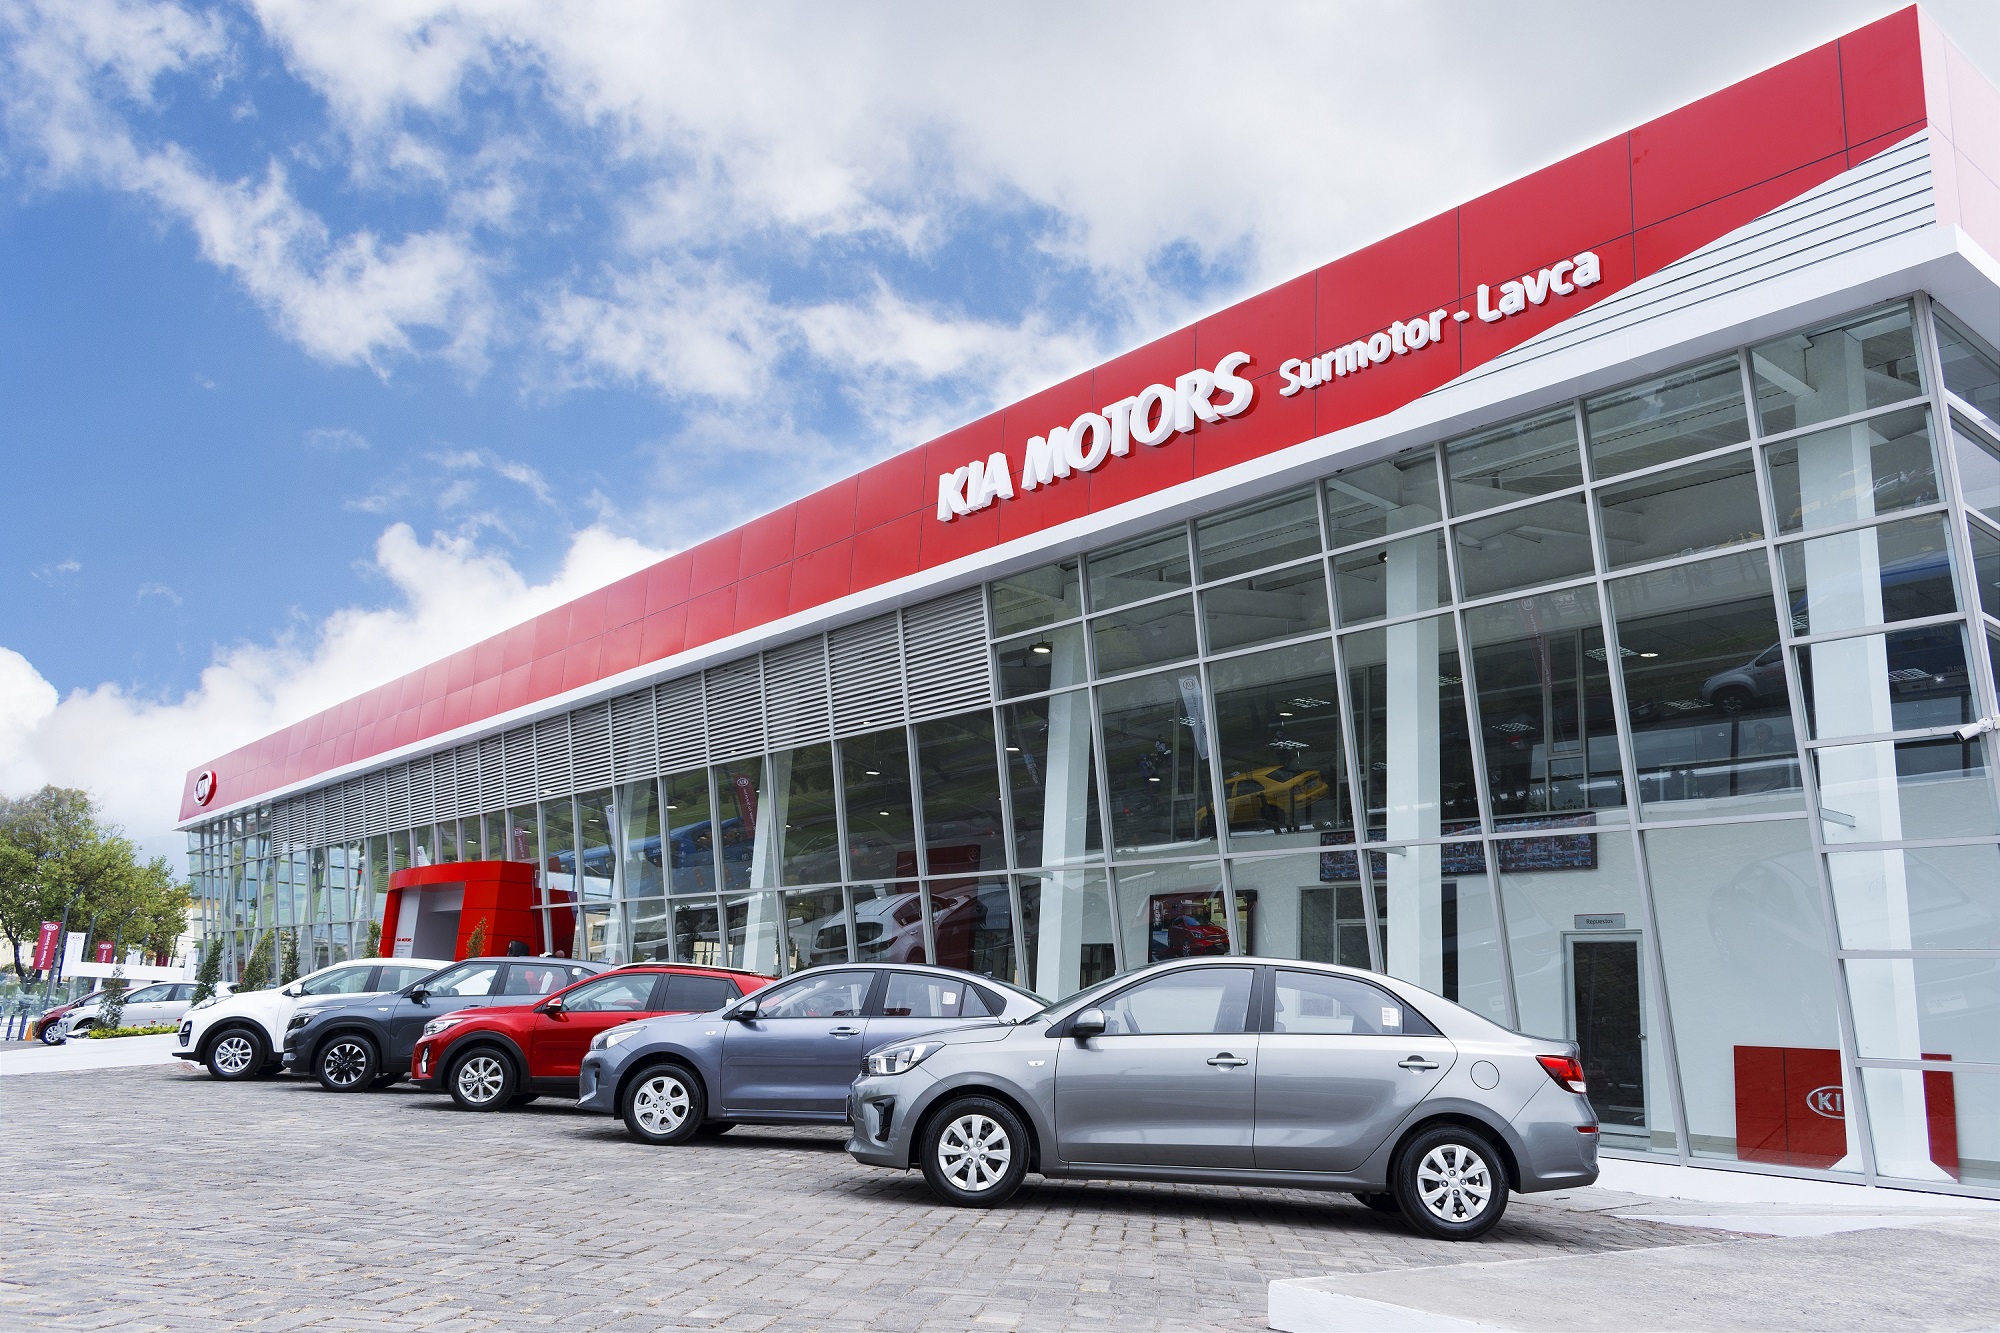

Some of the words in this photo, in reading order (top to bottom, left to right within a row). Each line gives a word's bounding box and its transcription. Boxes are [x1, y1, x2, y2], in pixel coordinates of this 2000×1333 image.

[1279, 308, 1447, 397] Surmotor
[1477, 251, 1600, 322] Lavca
[937, 452, 1014, 523] KIA
[1021, 351, 1254, 491] MOTORS
[1586, 918, 1613, 926] Repuestos
[1817, 1092, 1843, 1111] KI
